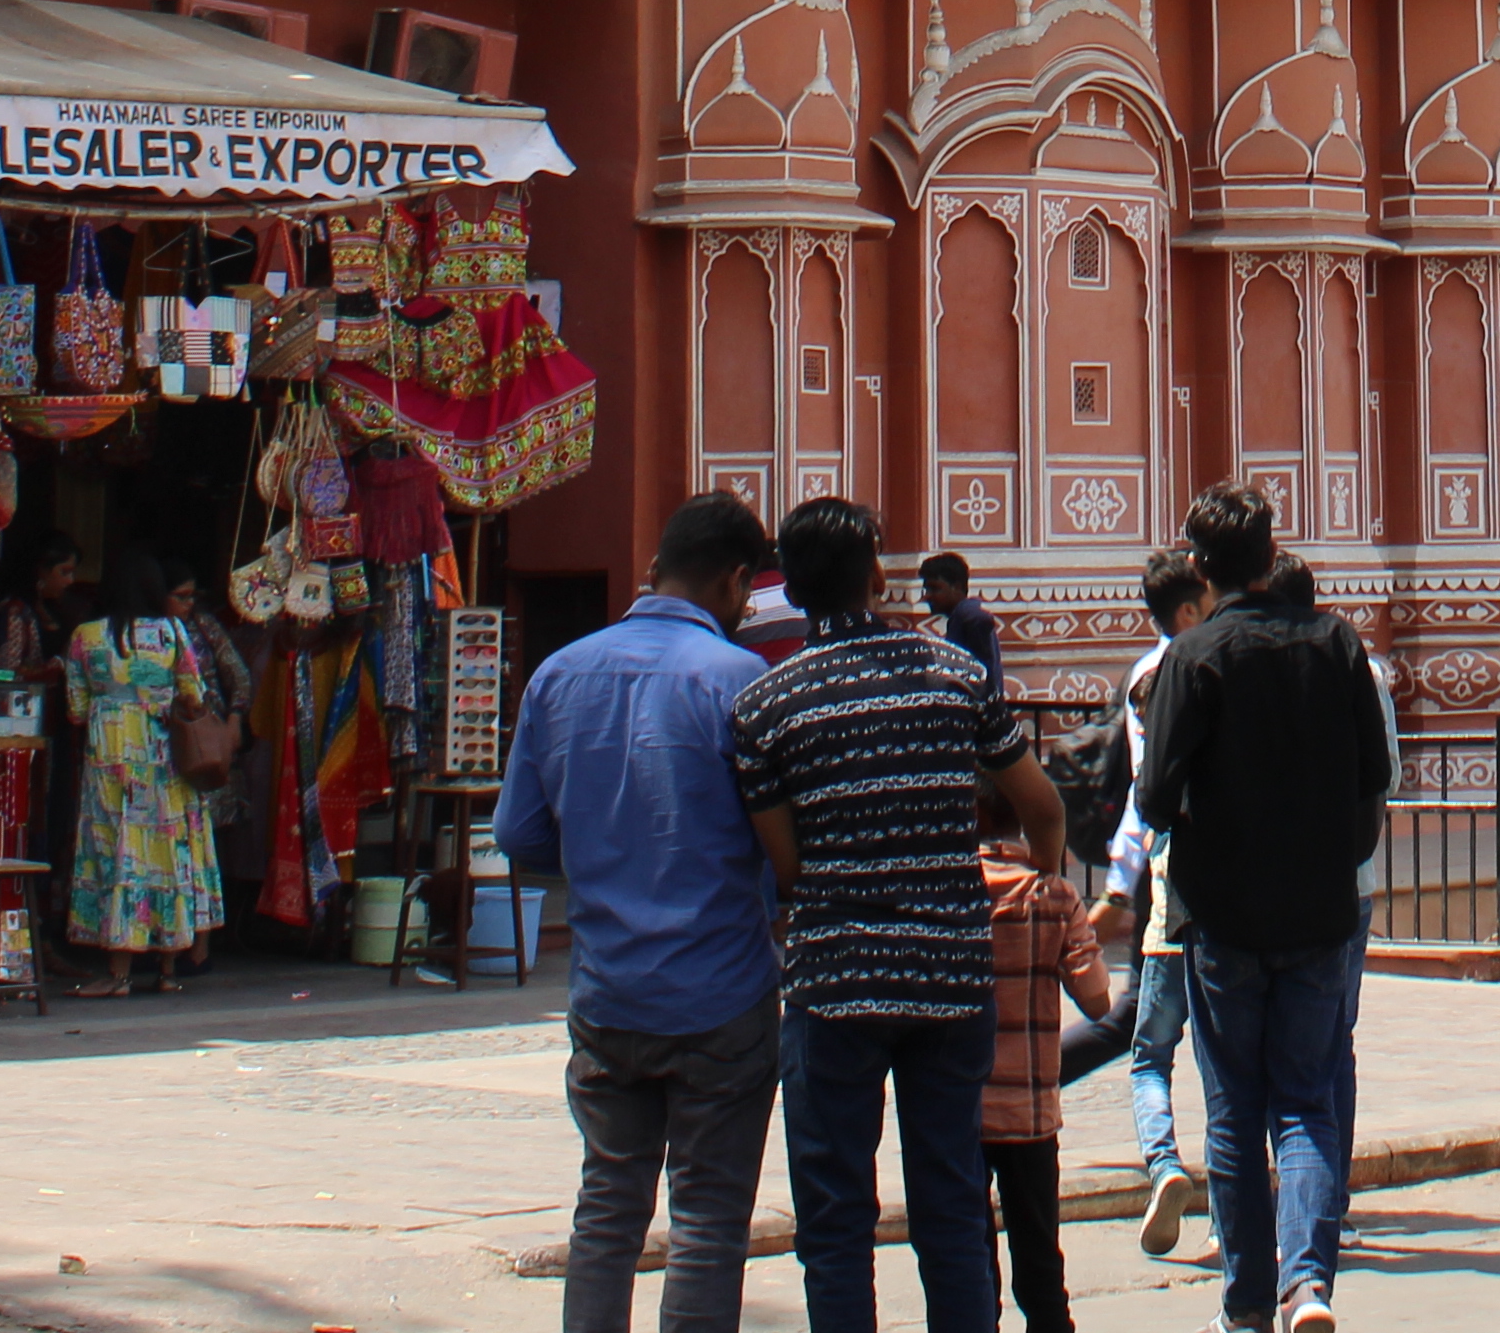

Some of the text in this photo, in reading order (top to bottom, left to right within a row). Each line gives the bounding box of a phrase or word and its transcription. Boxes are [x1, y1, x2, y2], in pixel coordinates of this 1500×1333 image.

[58, 102, 347, 133] HAWAMAHAL SAREE EMPORIUM
[209, 145, 223, 168] &
[226, 134, 494, 188] EXPORTER
